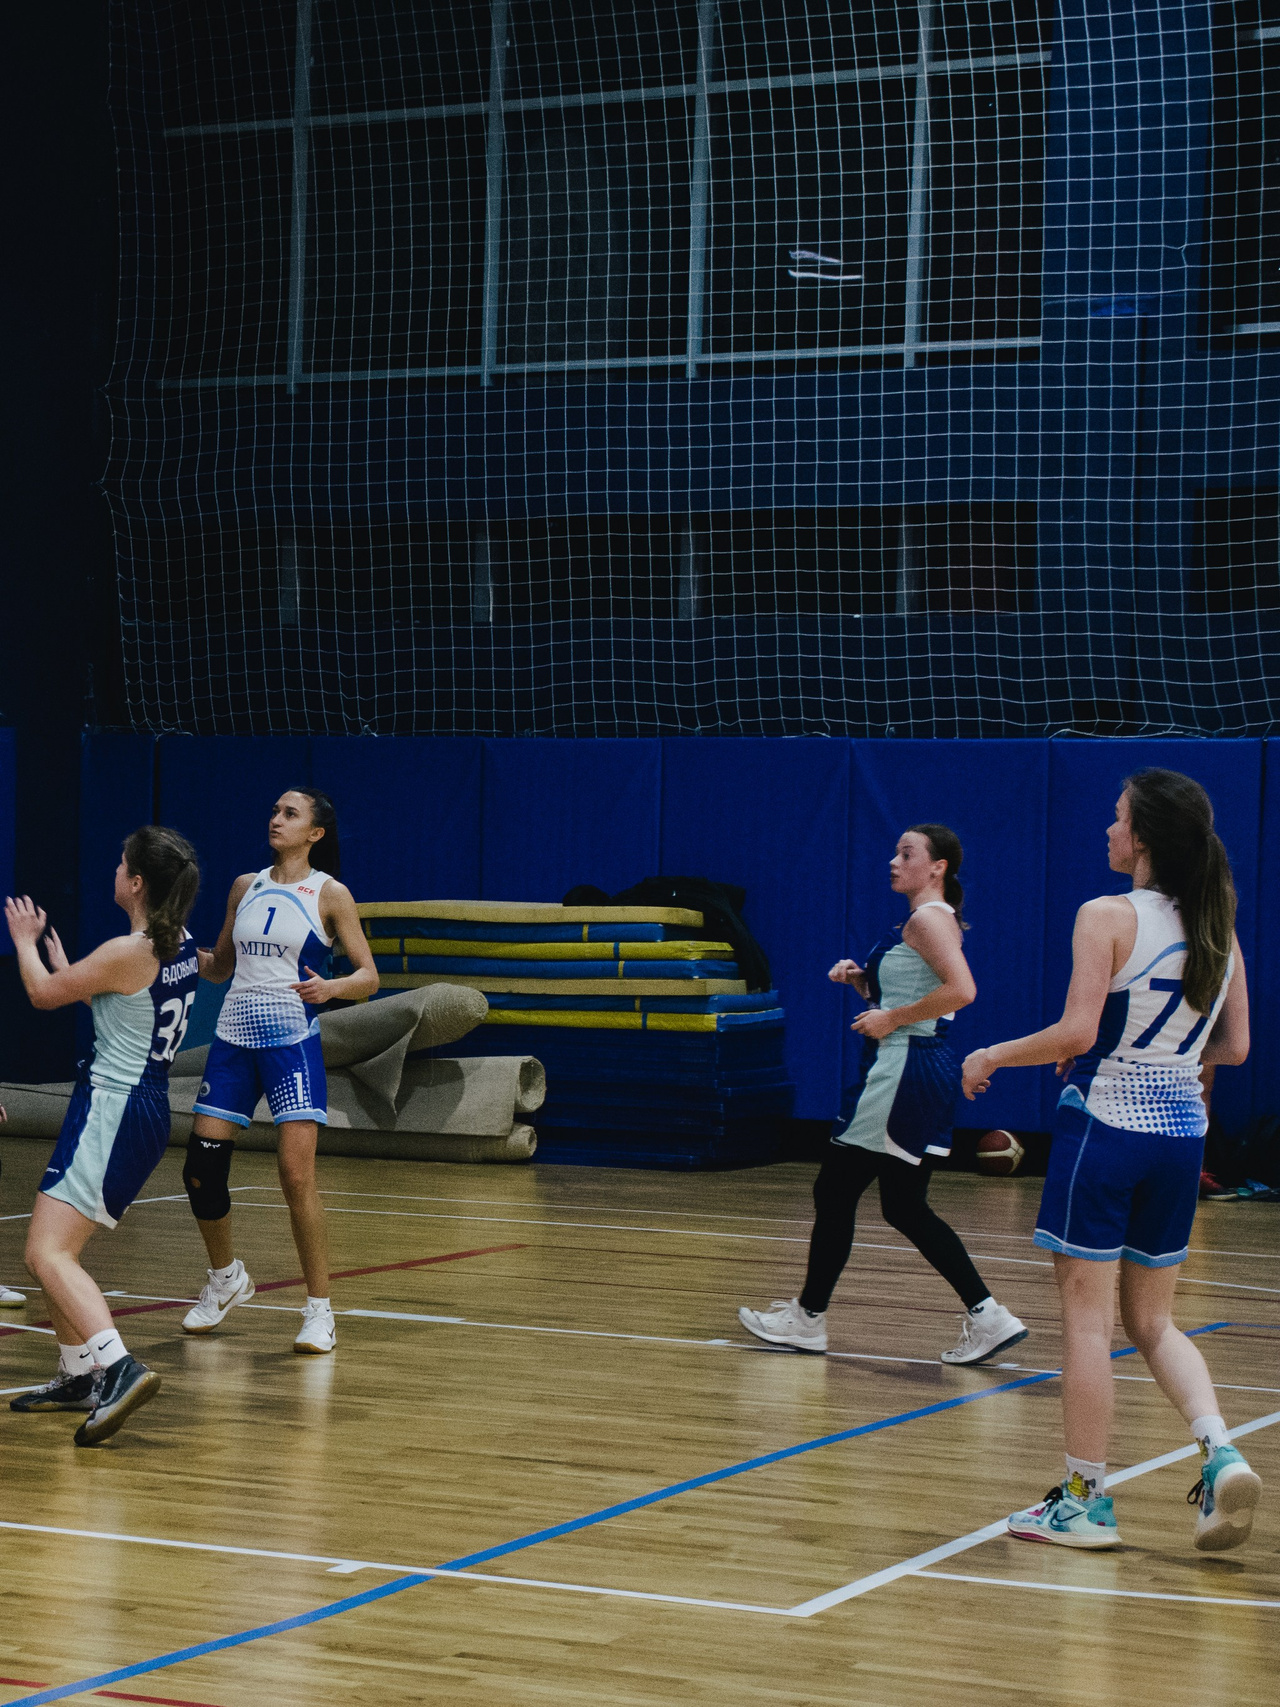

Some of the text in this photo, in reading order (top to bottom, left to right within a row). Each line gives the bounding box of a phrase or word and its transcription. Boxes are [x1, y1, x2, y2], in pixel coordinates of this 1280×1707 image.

[262, 906, 277, 935] 1
[239, 940, 289, 958] МПГУ
[150, 991, 196, 1063] 35
[293, 1072, 305, 1103] 1
